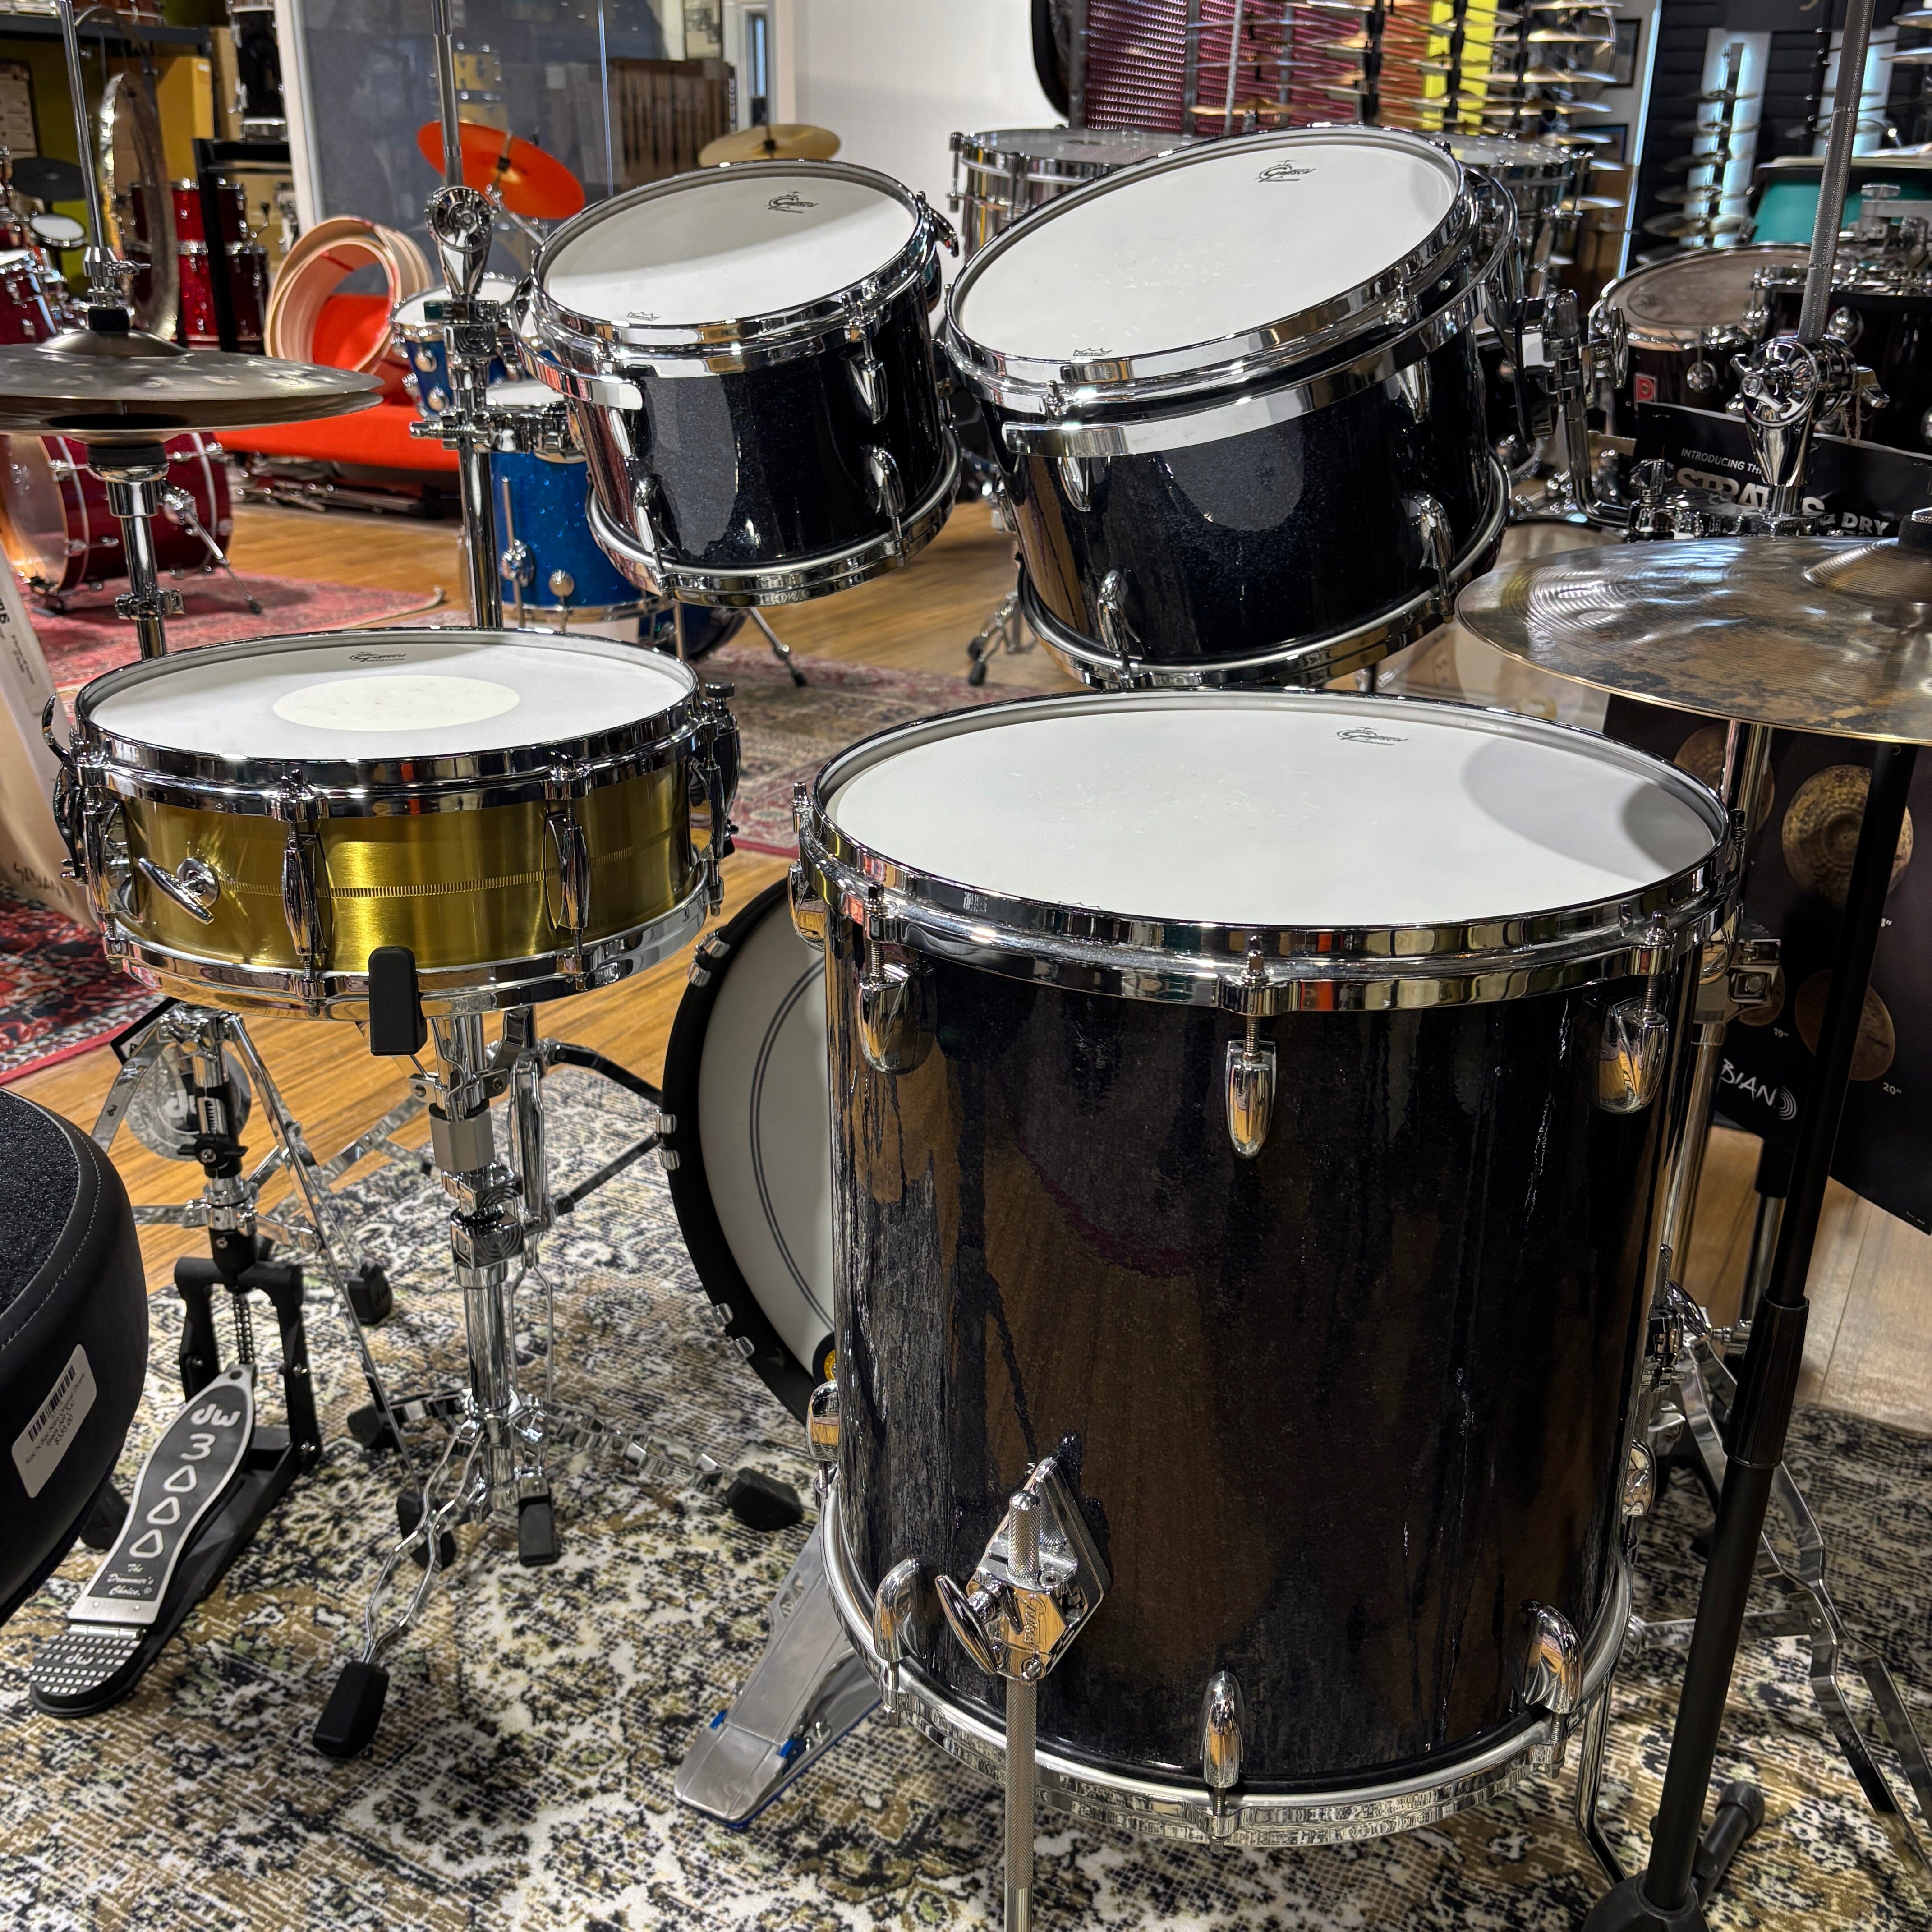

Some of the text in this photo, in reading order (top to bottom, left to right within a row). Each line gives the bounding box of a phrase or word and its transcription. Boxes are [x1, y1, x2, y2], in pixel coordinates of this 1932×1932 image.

[1680, 448, 1762, 474] INTRODUCING TH
[1676, 467, 1825, 515] STRATS
[1841, 512, 1890, 536] DRY
[1720, 1058, 1778, 1106] BIAN
[190, 1403, 241, 1426] dw
